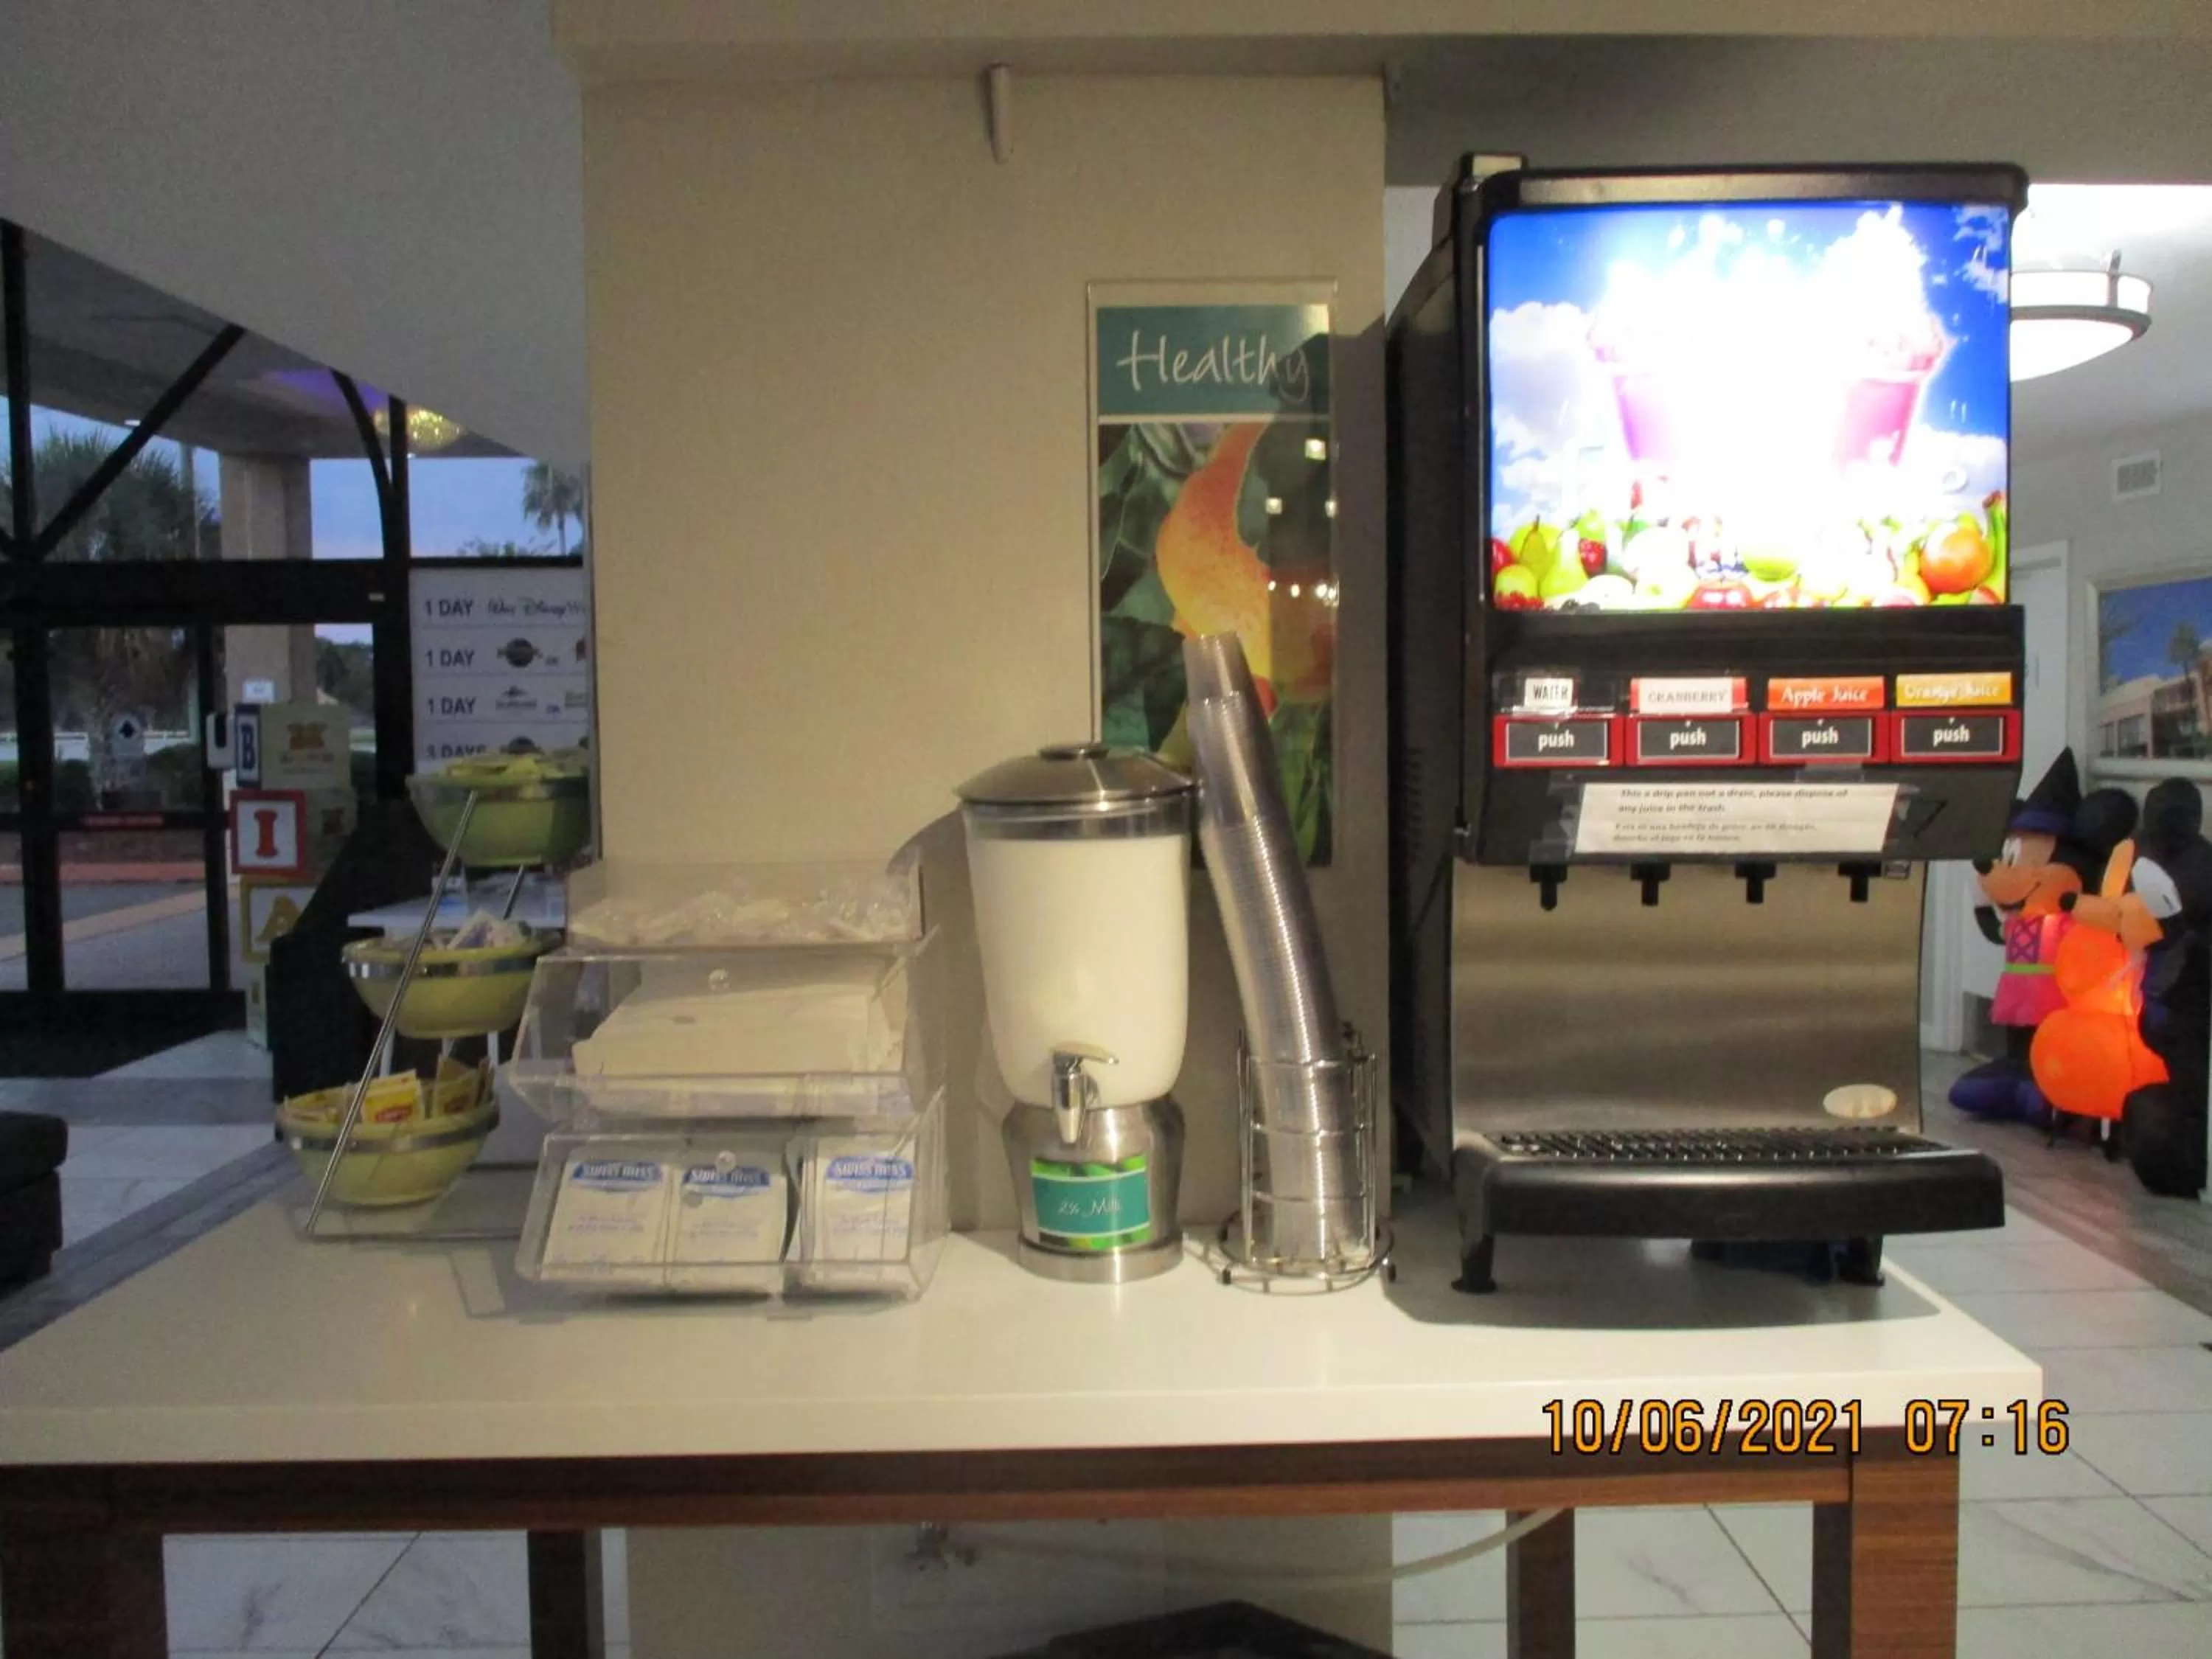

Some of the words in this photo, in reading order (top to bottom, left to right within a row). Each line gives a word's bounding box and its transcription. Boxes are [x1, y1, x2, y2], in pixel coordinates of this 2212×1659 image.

[1116, 330, 1310, 405] Healthy
[425, 599, 433, 616] 1
[438, 598, 474, 617] DAY
[425, 648, 434, 667] 1
[439, 647, 476, 668] DAY
[1647, 689, 1727, 704] CRANBERRY
[1781, 684, 1826, 709] Apple
[1831, 684, 1868, 702] Juice
[1904, 683, 1957, 703] Orange
[427, 697, 435, 714] 1
[440, 696, 476, 715] DAY
[240, 722, 257, 771] B
[1537, 730, 1575, 753] push
[1669, 726, 1707, 750] push
[1801, 726, 1839, 749] push
[1933, 724, 1970, 748] push
[253, 807, 279, 858] I
